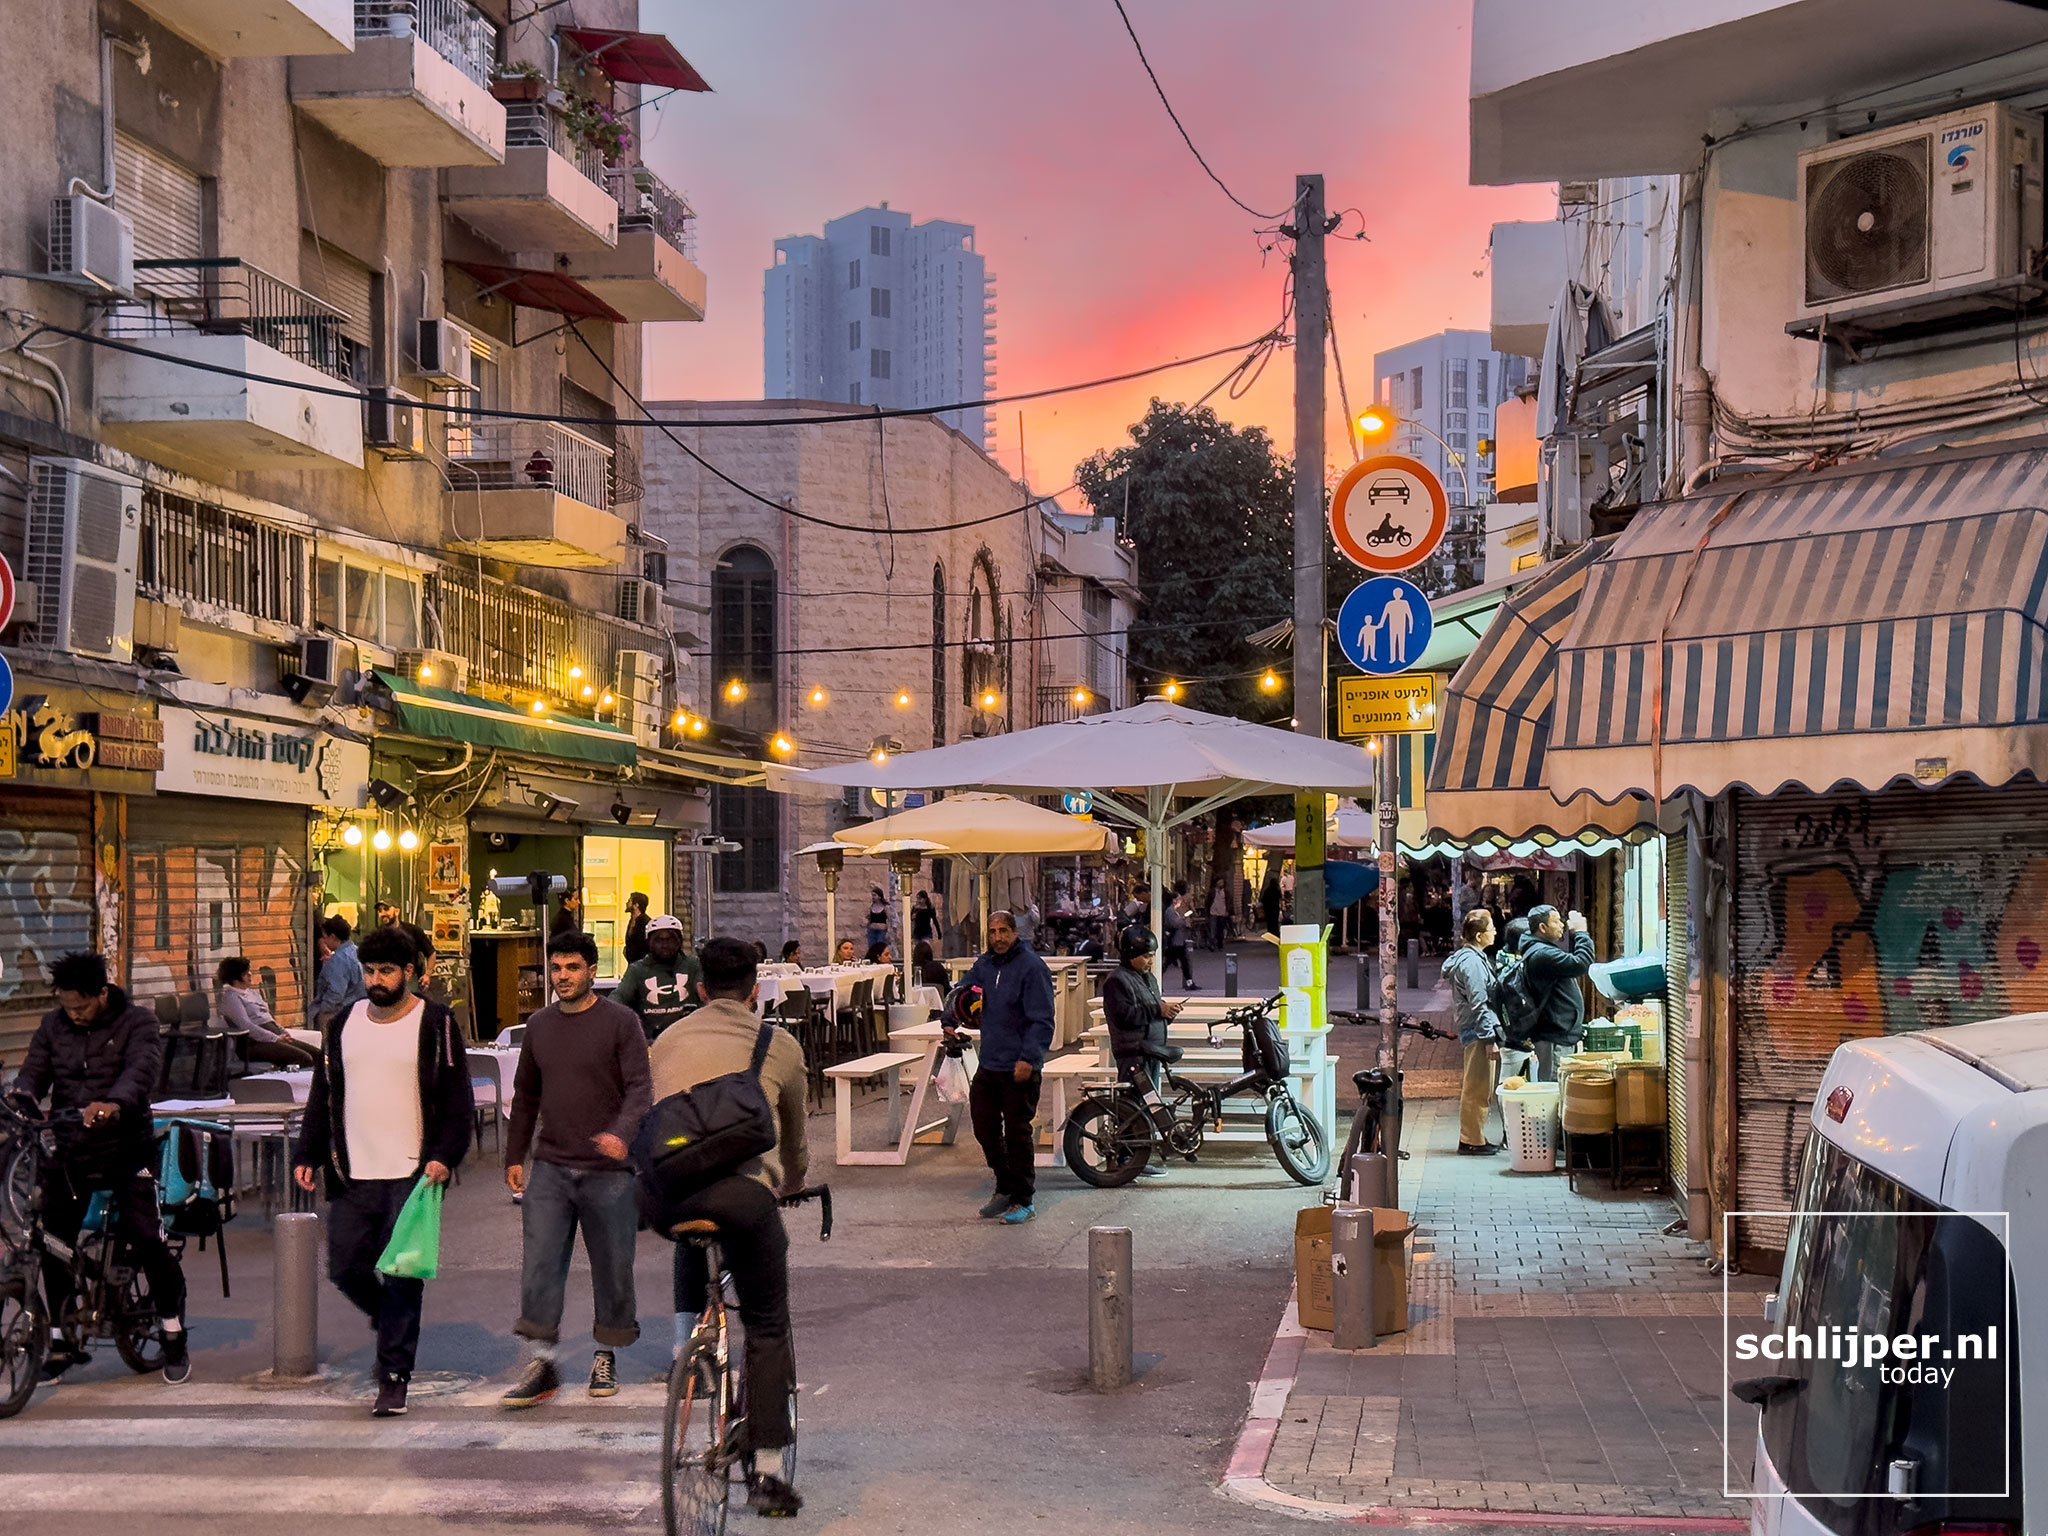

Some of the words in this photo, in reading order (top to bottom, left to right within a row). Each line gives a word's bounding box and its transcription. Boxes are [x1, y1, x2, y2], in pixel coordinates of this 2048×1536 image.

[1941, 124, 1983, 144] טורנדו
[1346, 690, 1390, 701] אופניים
[1393, 686, 1428, 699] למעט
[1352, 711, 1402, 724] ממונעים
[194, 718, 266, 760] החלבה
[272, 732, 314, 773] קסם
